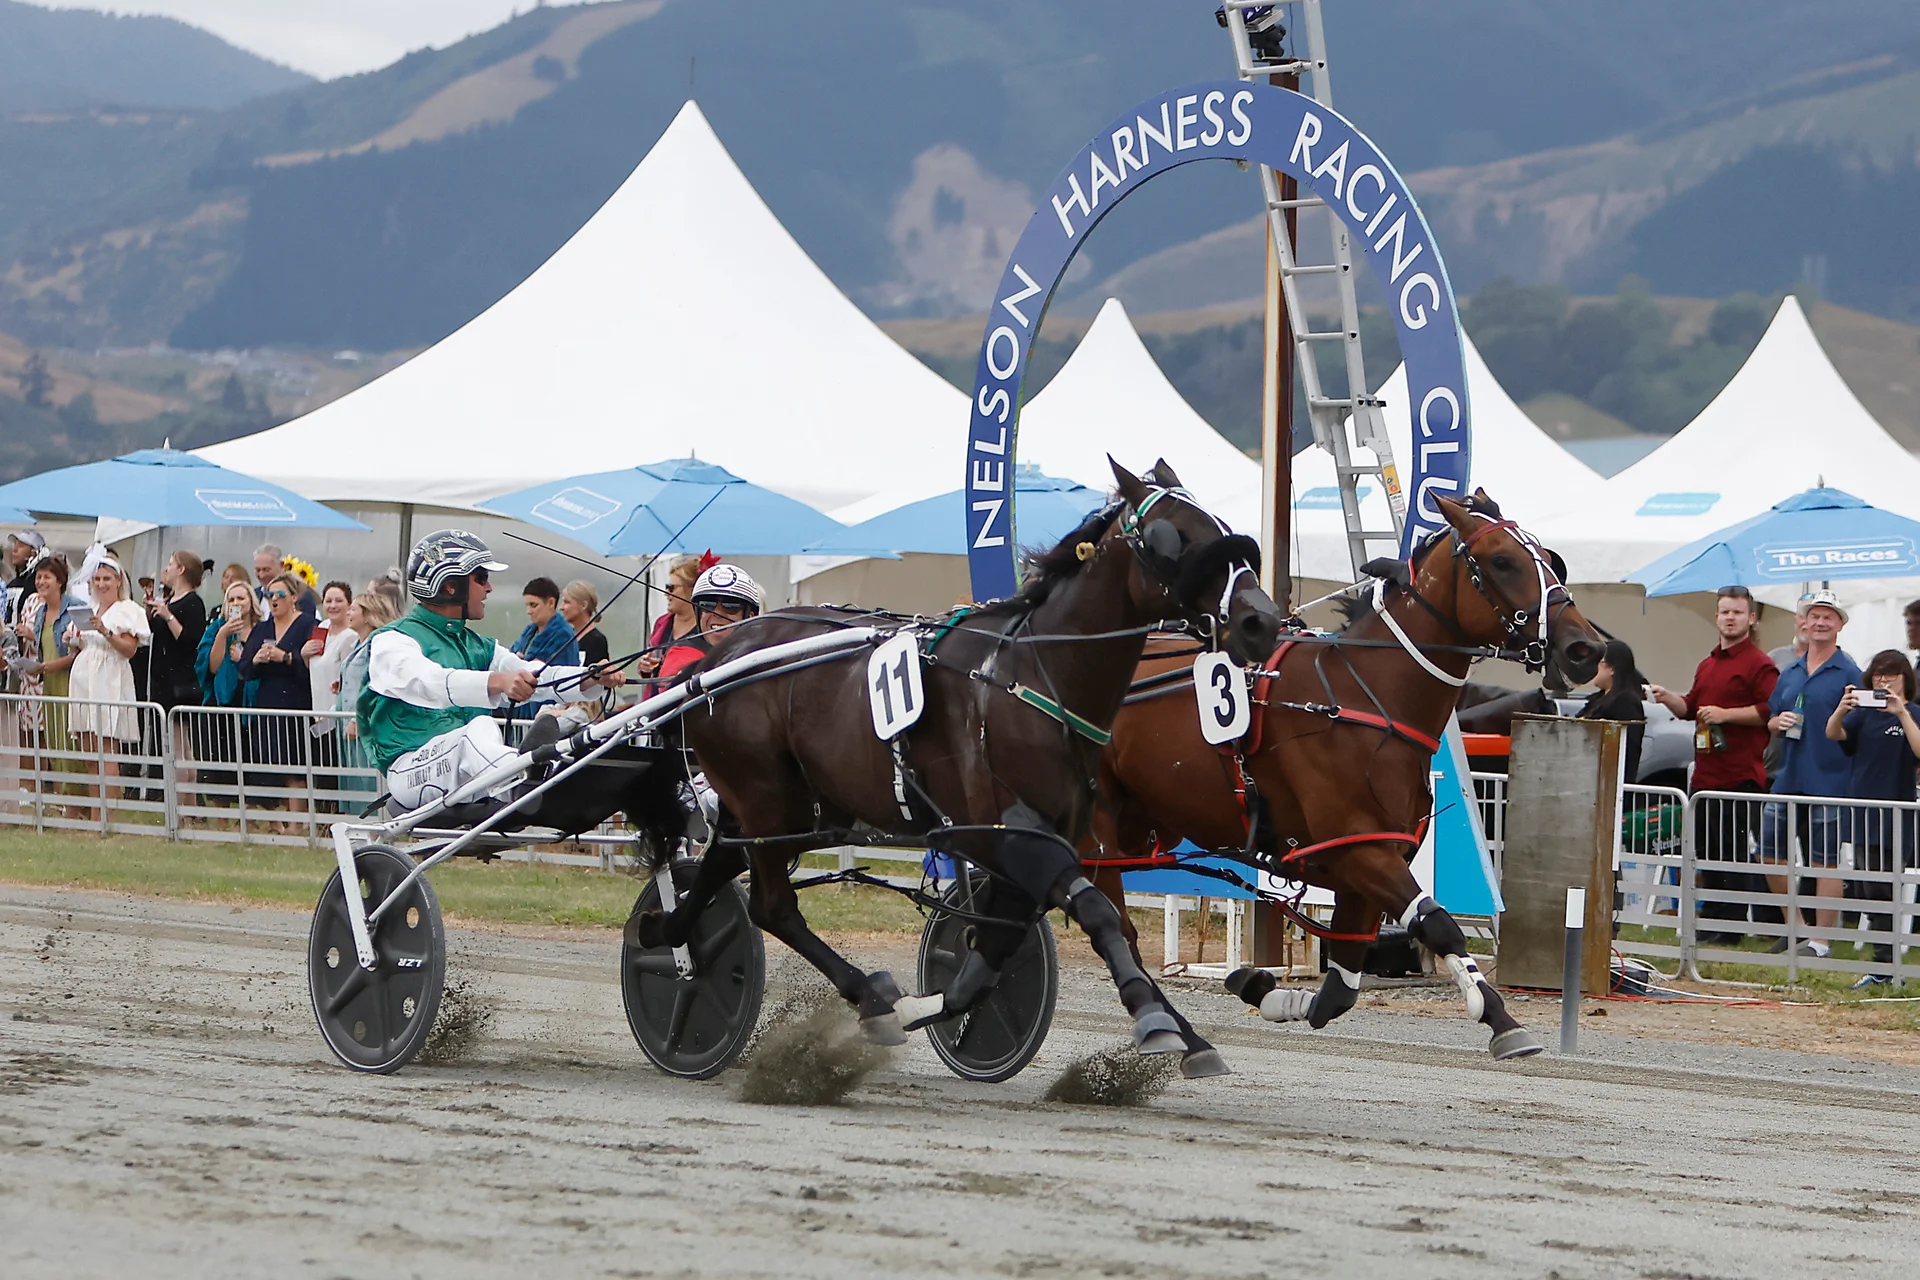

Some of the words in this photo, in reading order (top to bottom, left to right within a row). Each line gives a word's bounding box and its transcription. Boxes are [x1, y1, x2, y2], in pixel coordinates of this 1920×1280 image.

[973, 263, 1042, 549] NELSON
[1051, 89, 1255, 239] HARNESS
[1290, 111, 1440, 330] RACING
[1772, 552, 1821, 566] The
[1825, 548, 1900, 563] Races
[875, 649, 914, 725] 11
[1210, 662, 1236, 728] 3
[398, 958, 423, 967] LZR
